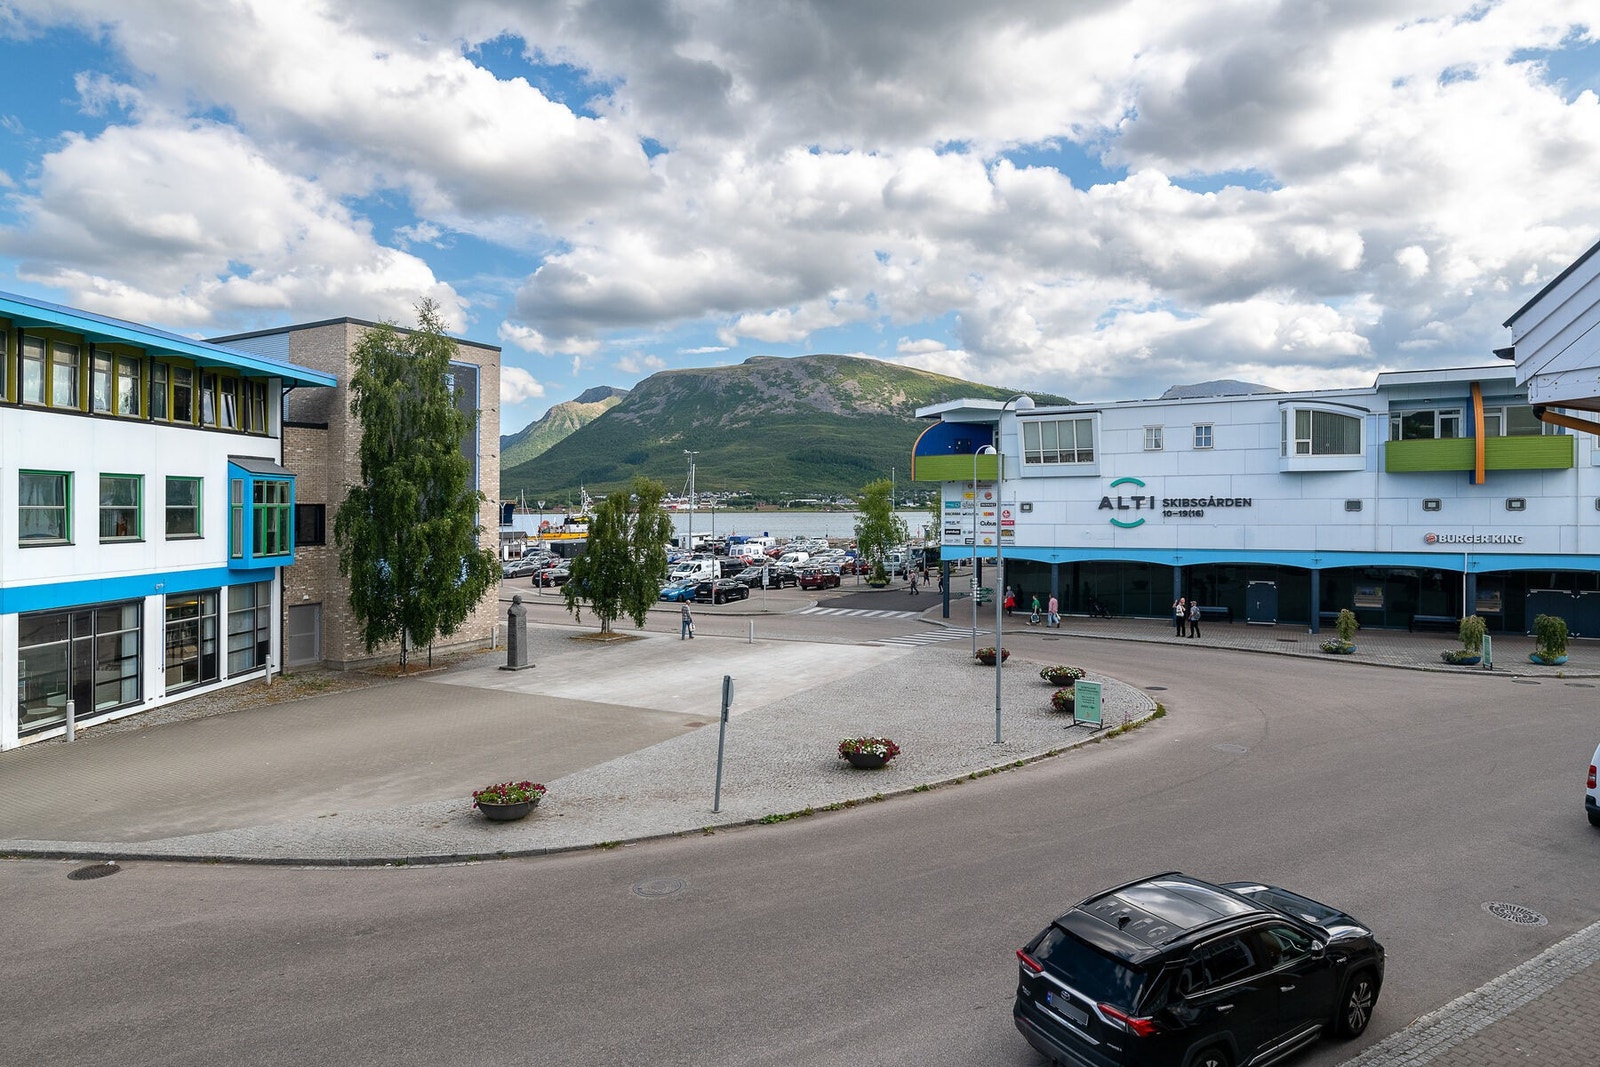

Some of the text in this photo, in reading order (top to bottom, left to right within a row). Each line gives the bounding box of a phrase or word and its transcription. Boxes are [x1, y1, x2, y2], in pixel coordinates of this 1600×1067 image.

[1098, 496, 1155, 510] ALTI
[1162, 496, 1252, 508] SKIBSGÅRDEN
[1438, 534, 1524, 544] BURGER KING
